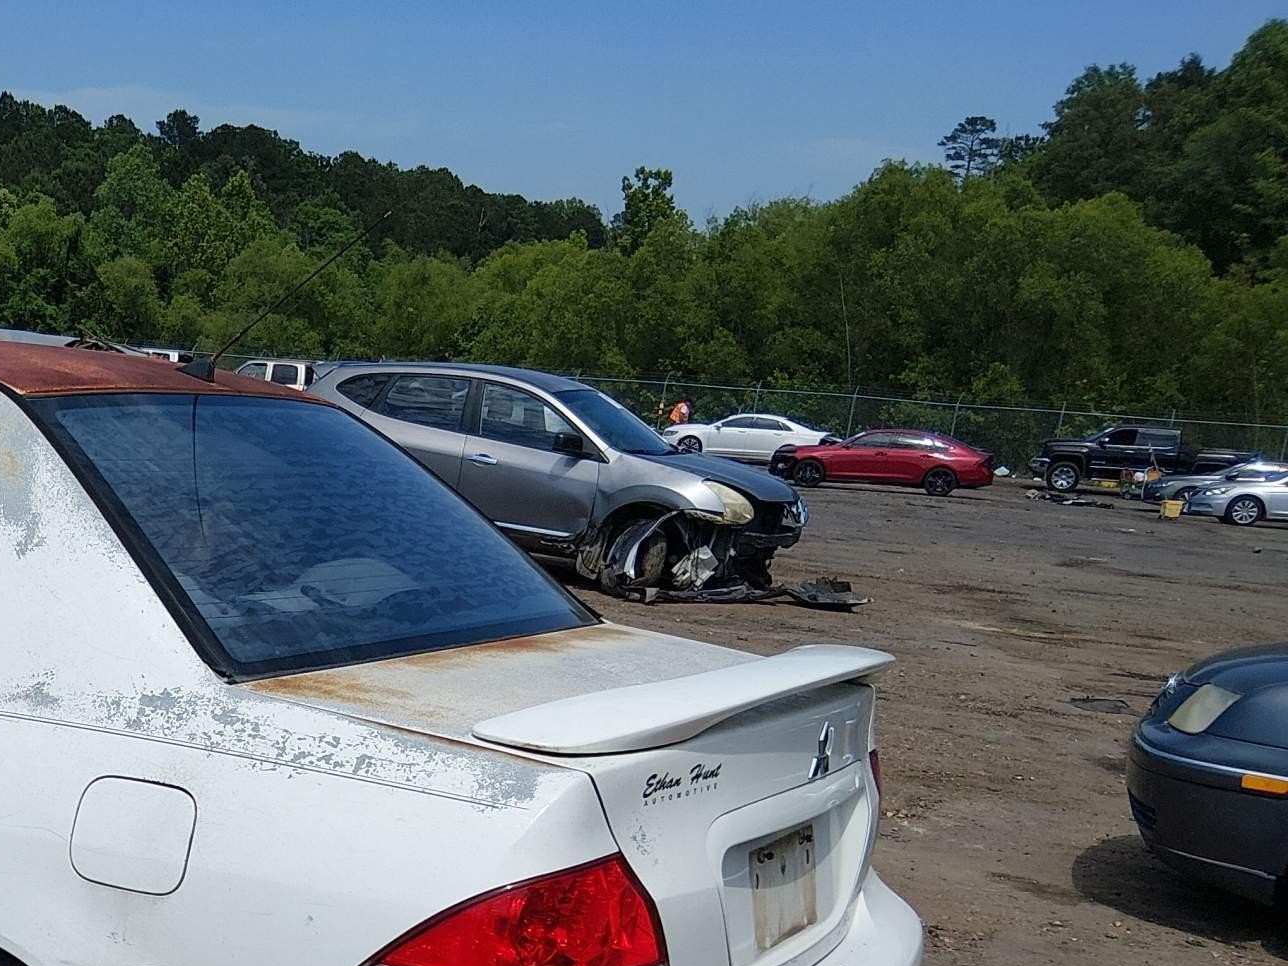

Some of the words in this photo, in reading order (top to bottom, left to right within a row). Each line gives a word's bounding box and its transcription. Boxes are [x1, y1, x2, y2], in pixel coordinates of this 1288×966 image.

[642, 771, 682, 799] Ethan
[689, 763, 722, 786] Hunt
[643, 782, 718, 807] AUTOMOTIVE
